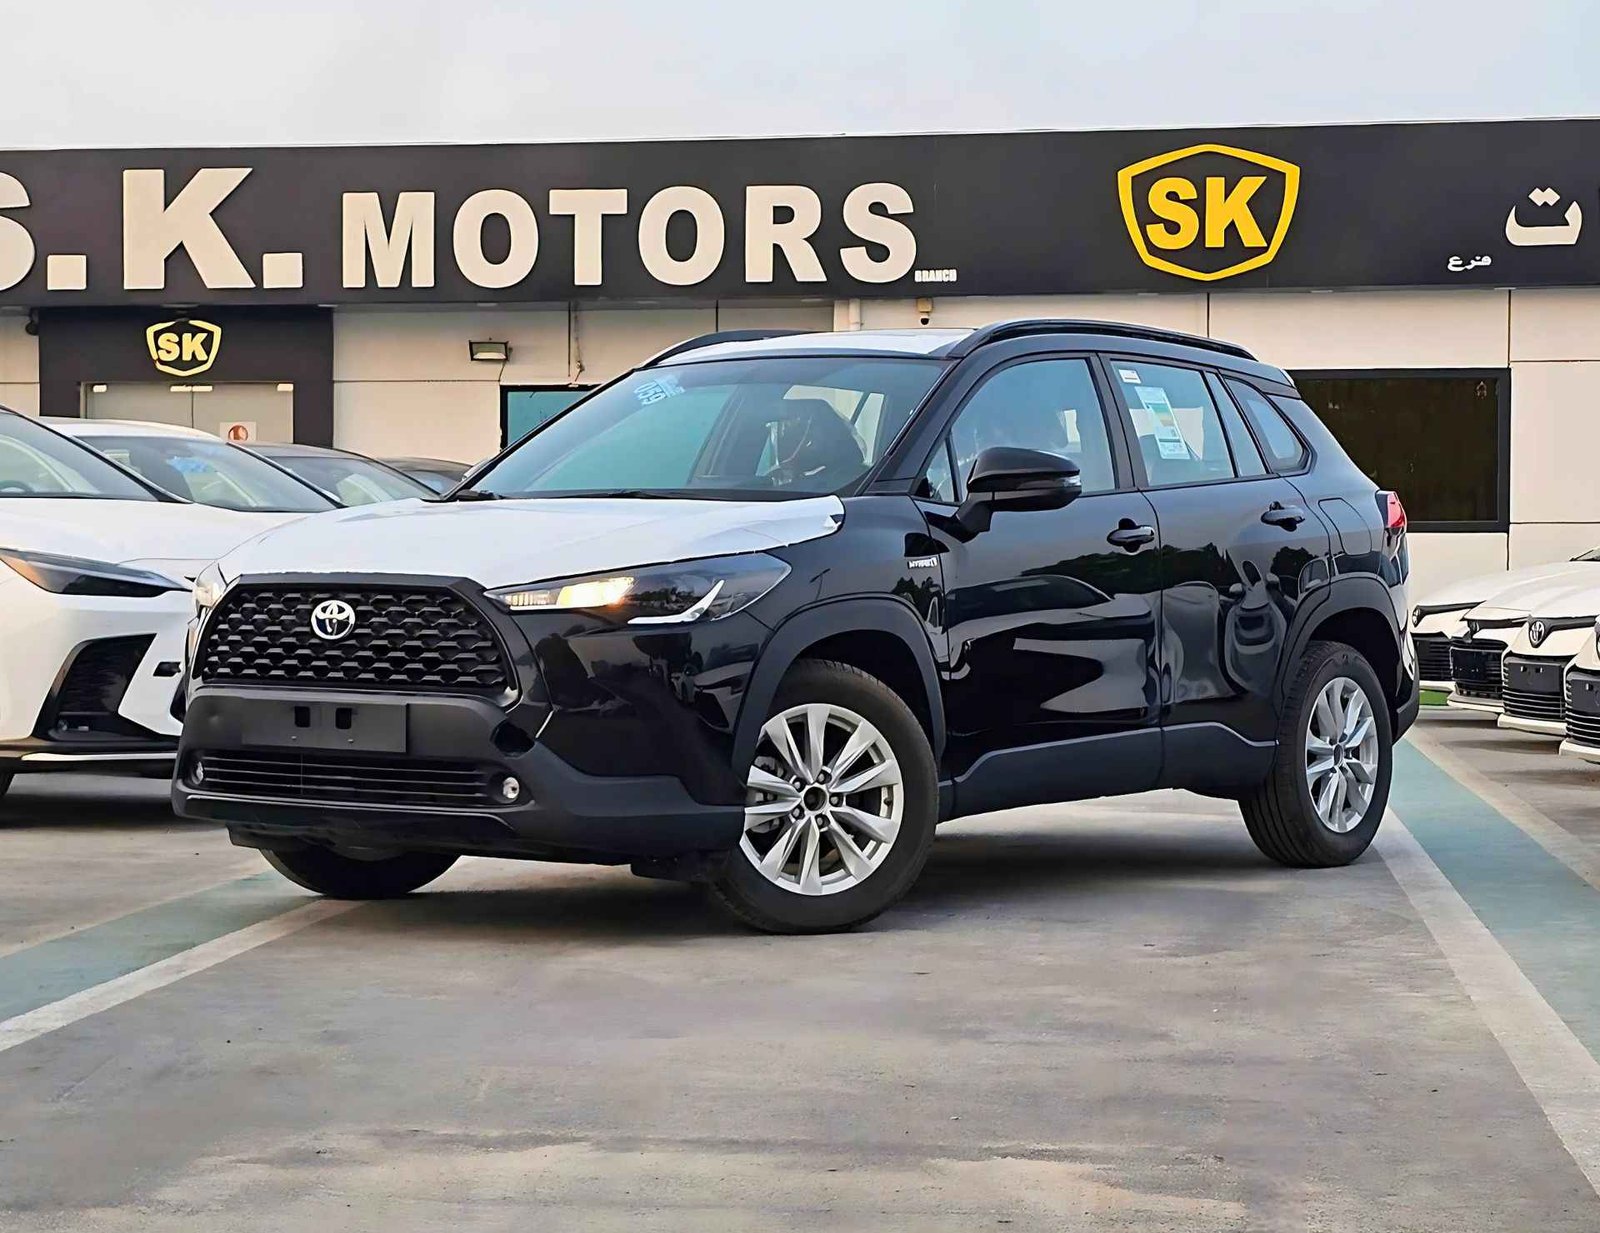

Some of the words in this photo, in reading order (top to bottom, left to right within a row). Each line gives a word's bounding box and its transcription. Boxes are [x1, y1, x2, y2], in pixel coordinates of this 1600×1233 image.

[342, 182, 917, 289] MOTORS
[1145, 176, 1268, 250] SK
[1505, 187, 1583, 247] ت
[157, 332, 209, 362] SK
